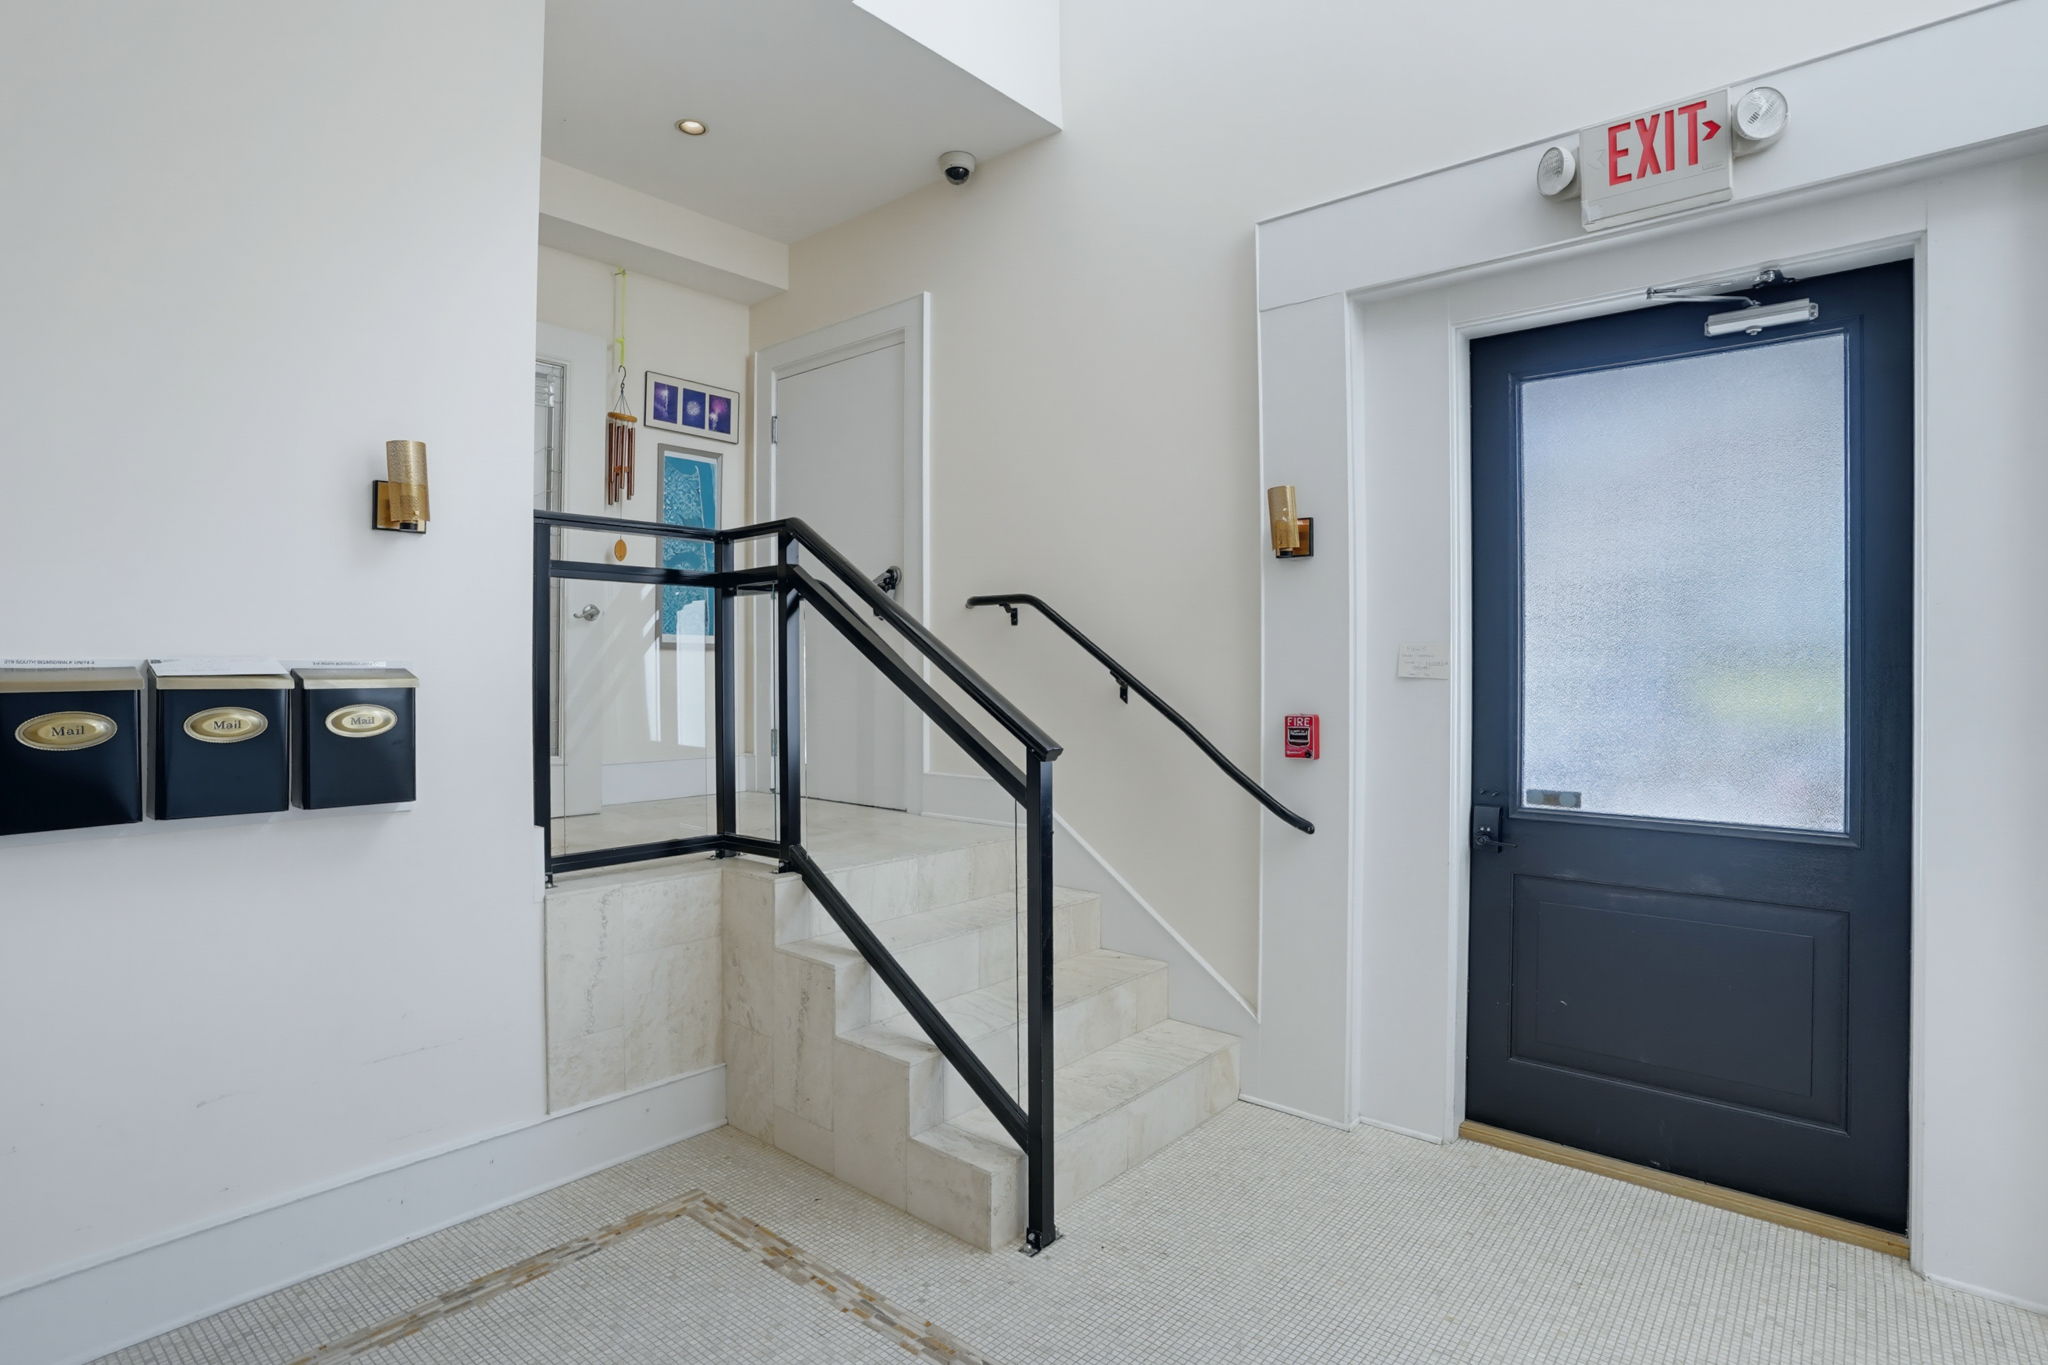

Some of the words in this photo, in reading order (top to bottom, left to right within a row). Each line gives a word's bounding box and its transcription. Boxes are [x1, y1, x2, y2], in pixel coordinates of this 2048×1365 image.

[1608, 100, 1707, 186] EXIT
[213, 718, 242, 731] Mail
[350, 715, 375, 727] Mail
[1287, 717, 1310, 727] FIRE
[51, 725, 85, 737] Mail
